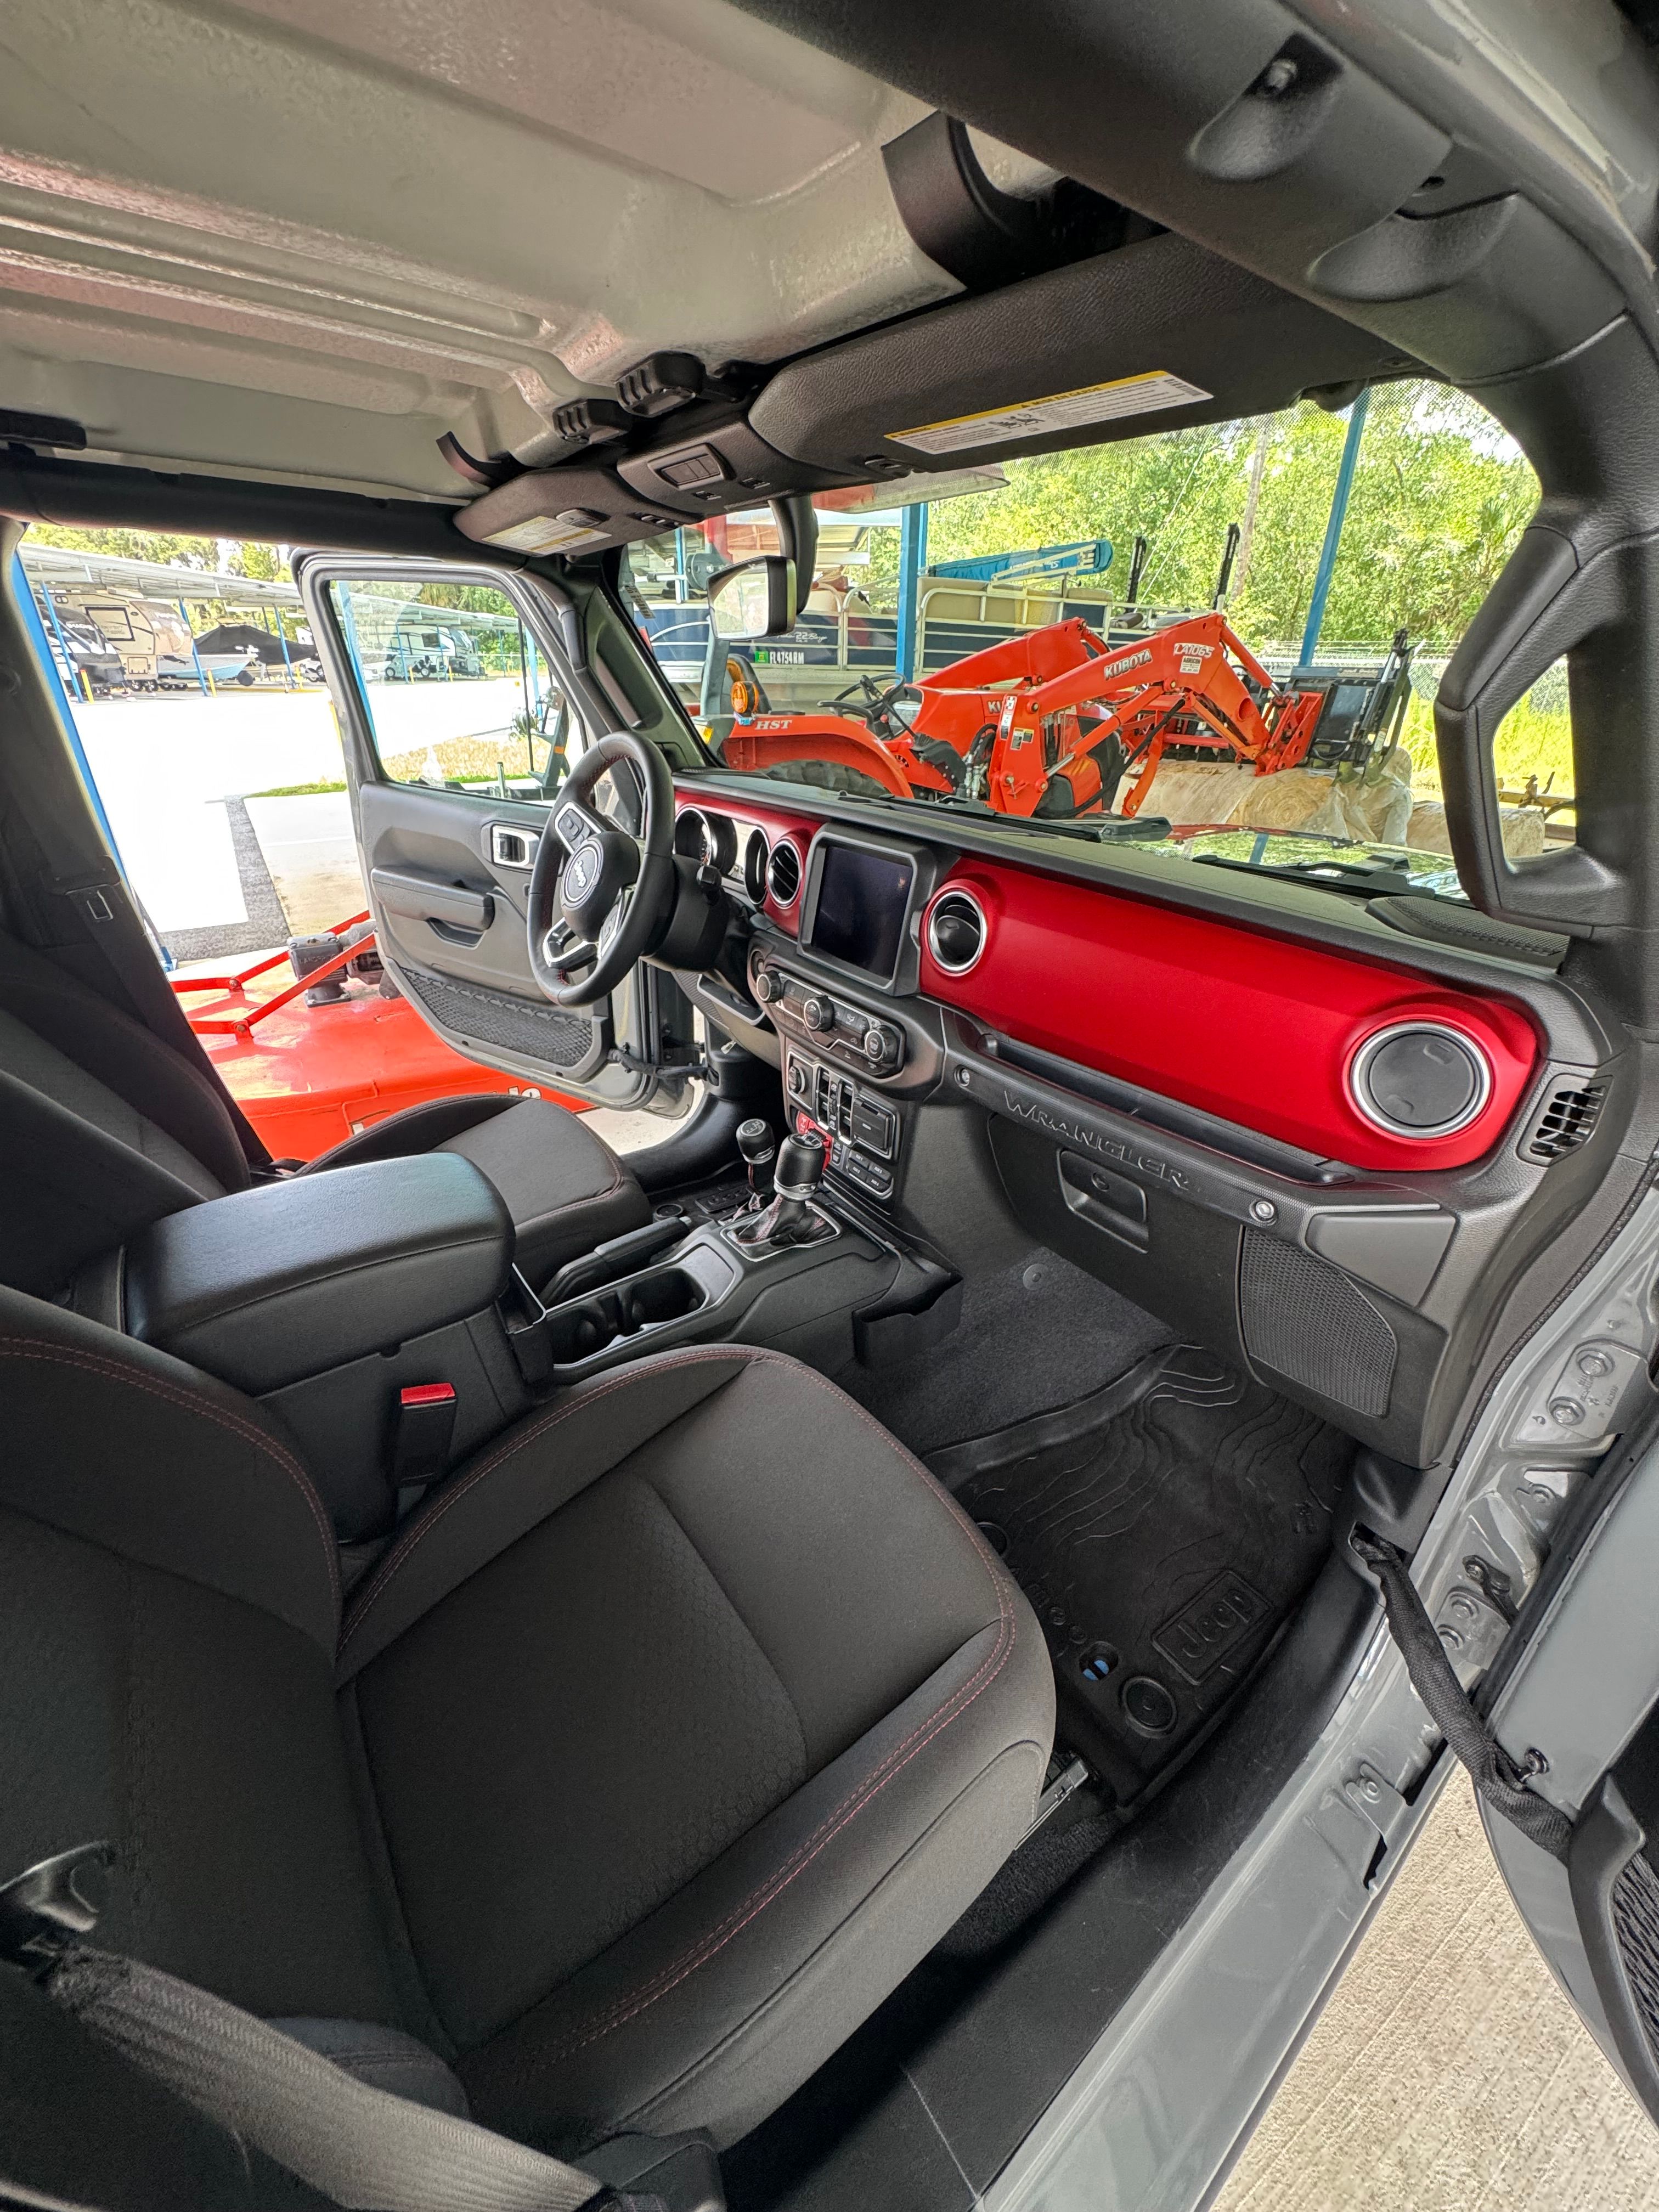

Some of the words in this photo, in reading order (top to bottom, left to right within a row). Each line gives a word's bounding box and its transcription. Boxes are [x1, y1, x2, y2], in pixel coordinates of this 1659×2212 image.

[1105, 648, 1152, 680] KUBOTA
[755, 720, 792, 730] HST
[1004, 1090, 1189, 1191] WRANGLER
[1177, 1589, 1252, 1658] Jeep
